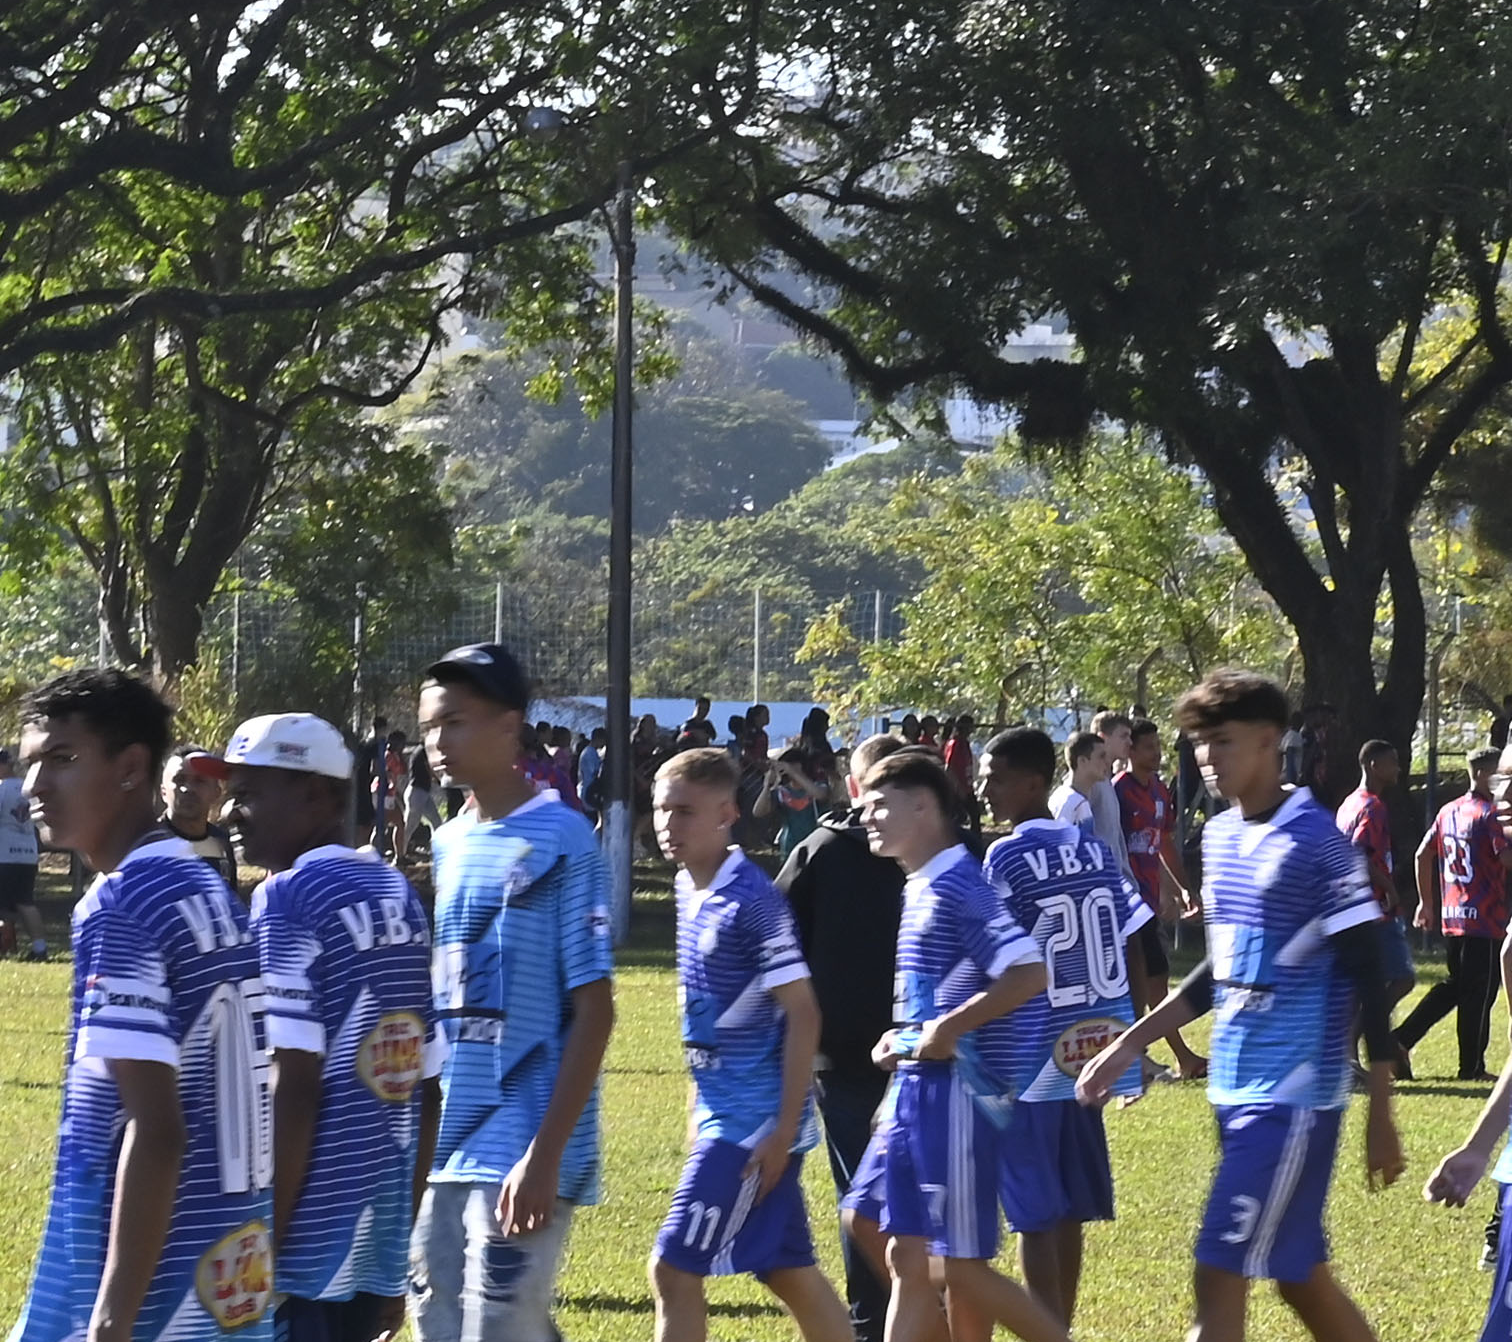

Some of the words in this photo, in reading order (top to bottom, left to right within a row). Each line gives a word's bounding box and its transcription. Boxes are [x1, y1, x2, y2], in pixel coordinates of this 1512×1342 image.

[1023, 841, 1105, 881] V.B.V
[1034, 886, 1131, 1009] 20
[683, 1199, 722, 1252] 11
[1220, 1194, 1262, 1245] 3
